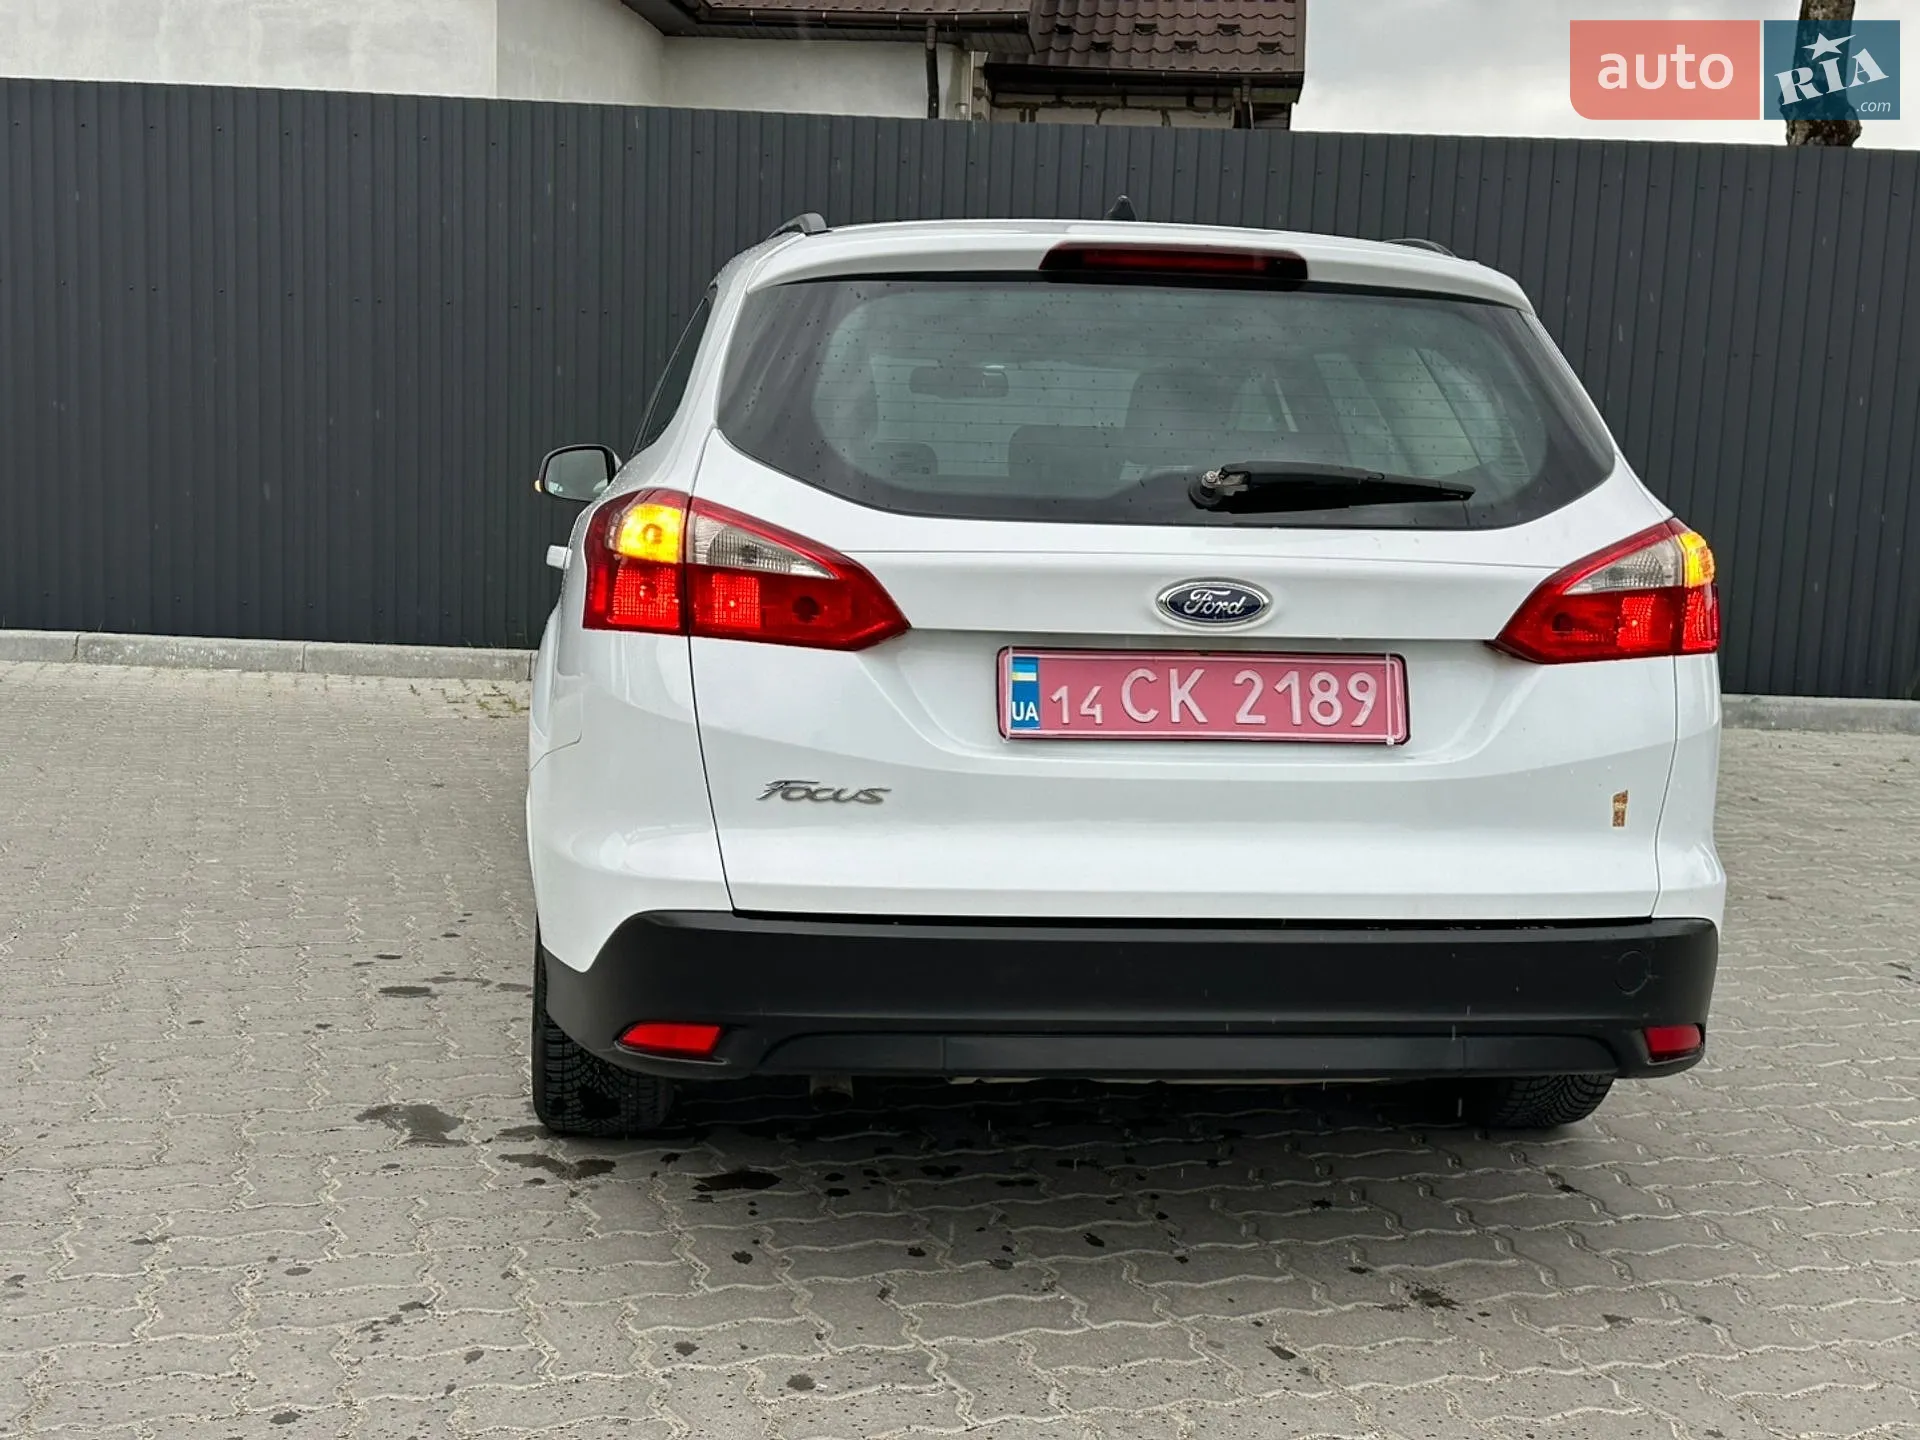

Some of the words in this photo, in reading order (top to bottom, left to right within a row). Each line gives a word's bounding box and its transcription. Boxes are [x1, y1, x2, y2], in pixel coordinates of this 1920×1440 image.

[1184, 589, 1246, 614] Ford
[1050, 685, 1103, 724] 14
[1121, 668, 1208, 724] CK
[1234, 669, 1378, 727] 2189
[1012, 701, 1039, 722] UA
[756, 780, 892, 805] Focus
